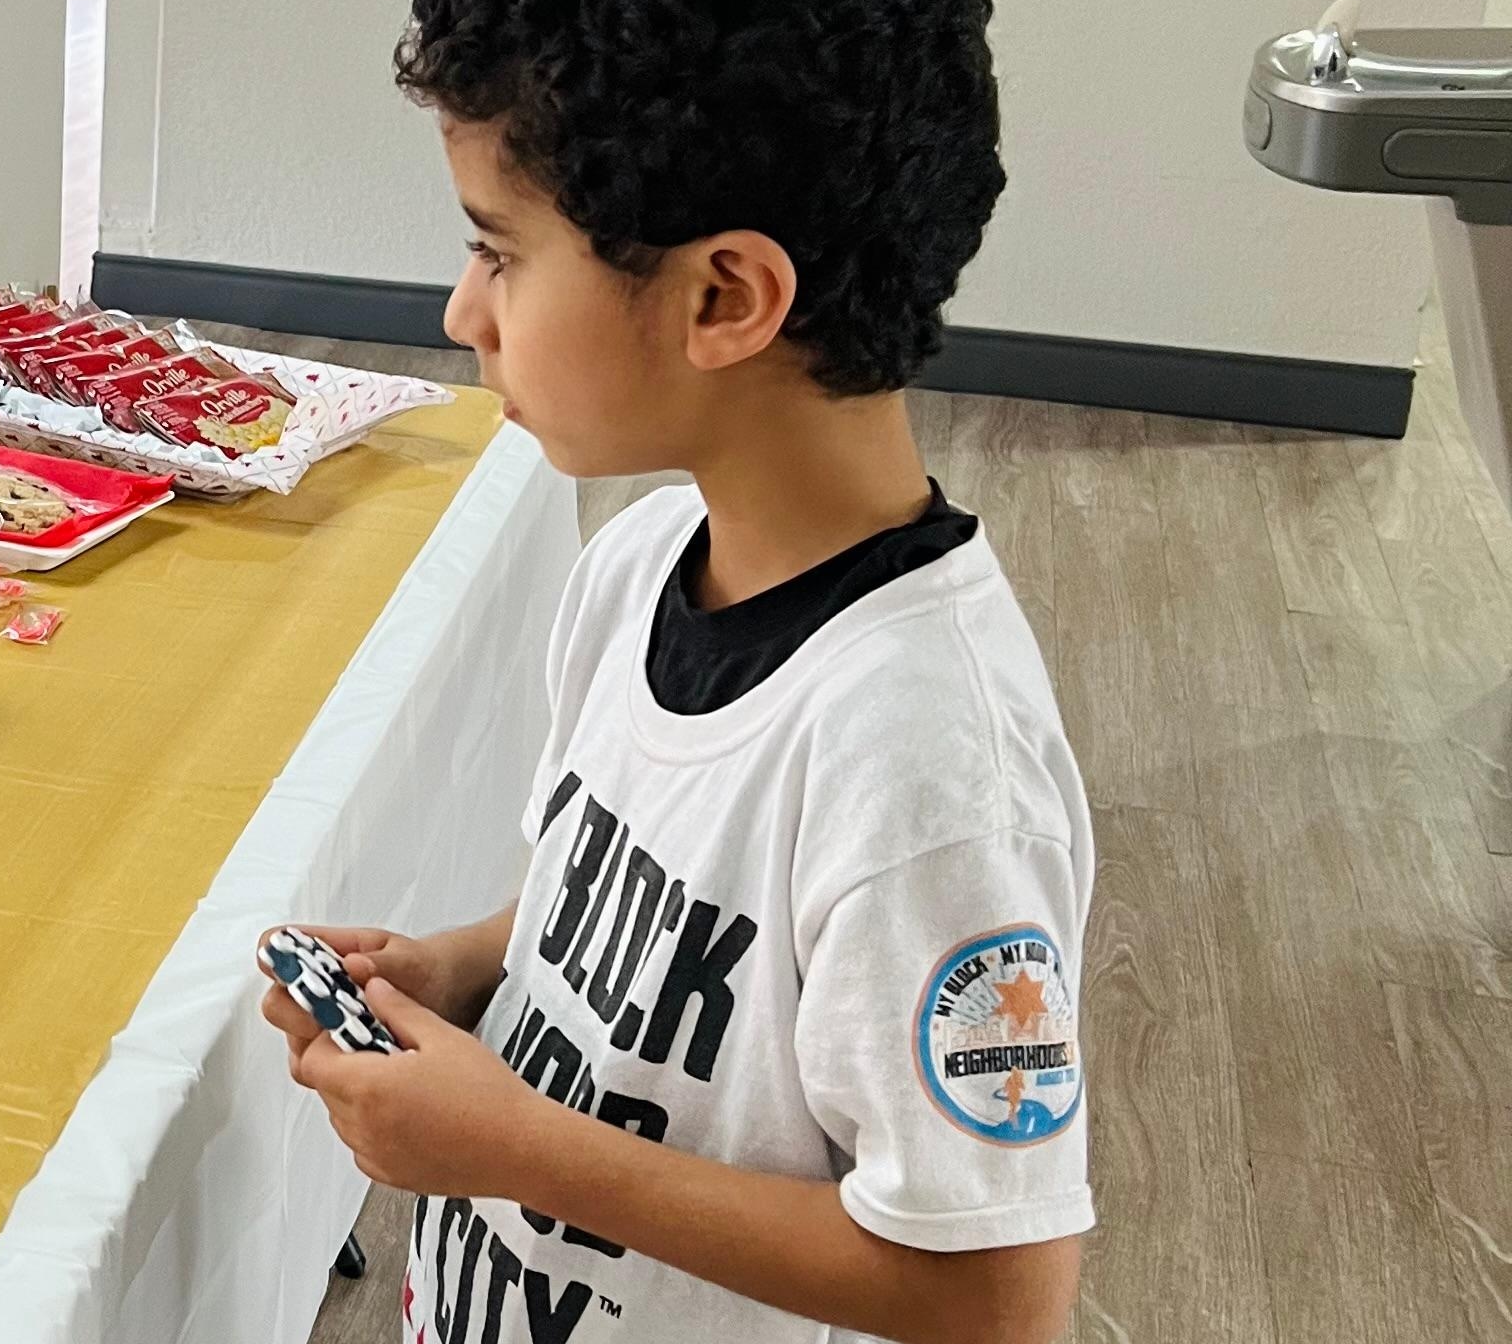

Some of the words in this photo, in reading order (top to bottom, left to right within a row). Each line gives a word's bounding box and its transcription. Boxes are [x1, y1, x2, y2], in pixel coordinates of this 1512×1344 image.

[143, 367, 190, 396] Orville
[201, 389, 251, 416] Orville
[539, 793, 758, 1083] BLOCK
[935, 994, 956, 1017] MY
[999, 943, 1021, 966] MY
